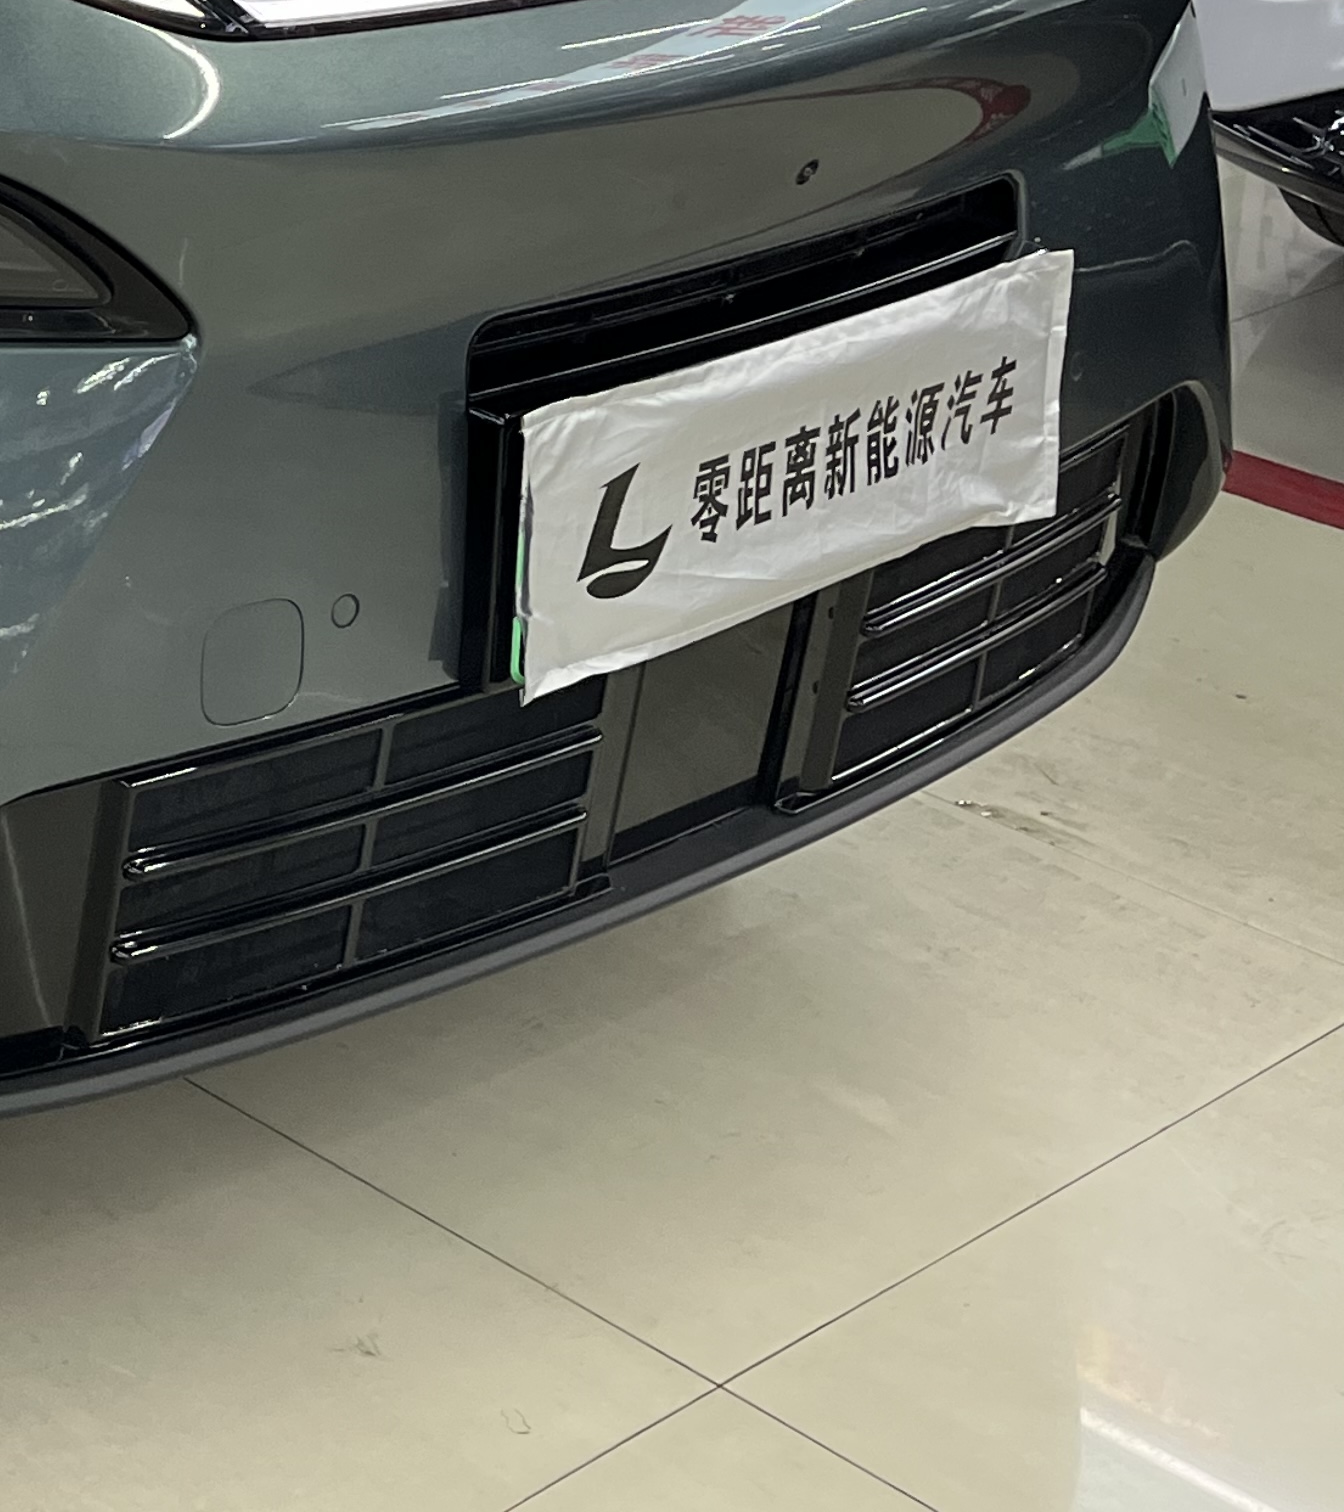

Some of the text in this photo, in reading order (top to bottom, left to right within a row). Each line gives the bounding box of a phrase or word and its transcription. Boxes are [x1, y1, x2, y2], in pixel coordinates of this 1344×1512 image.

[689, 356, 1017, 544] 零距离新能源汽车
